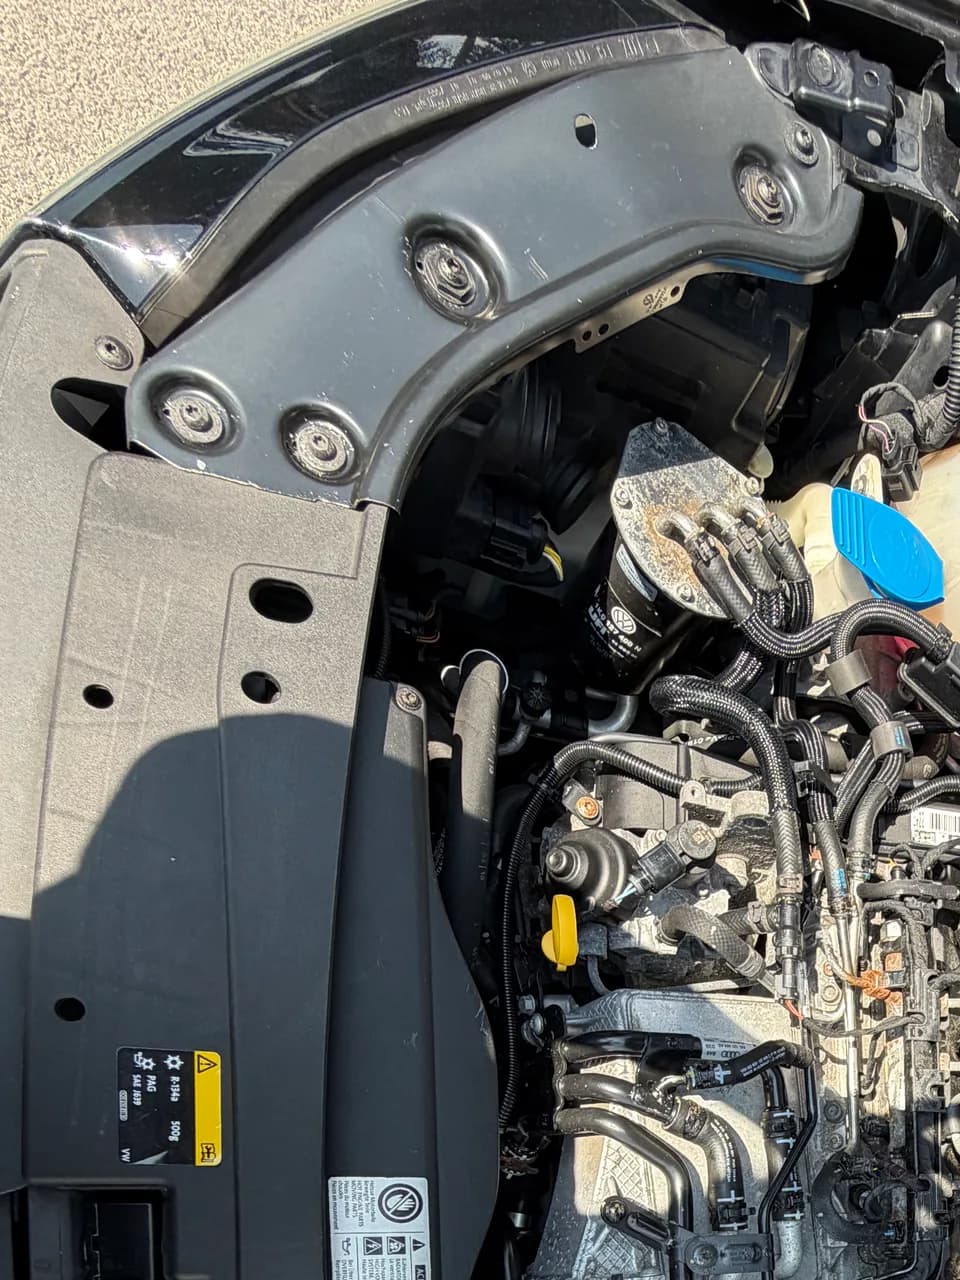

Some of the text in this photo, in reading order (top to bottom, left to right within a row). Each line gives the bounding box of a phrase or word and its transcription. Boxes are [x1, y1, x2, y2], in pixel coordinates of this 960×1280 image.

[132, 1074, 141, 1105] SAE J639
[147, 1075, 156, 1092] PAG
[169, 1076, 180, 1142] R-134a 500g
[121, 1148, 130, 1162] VW
